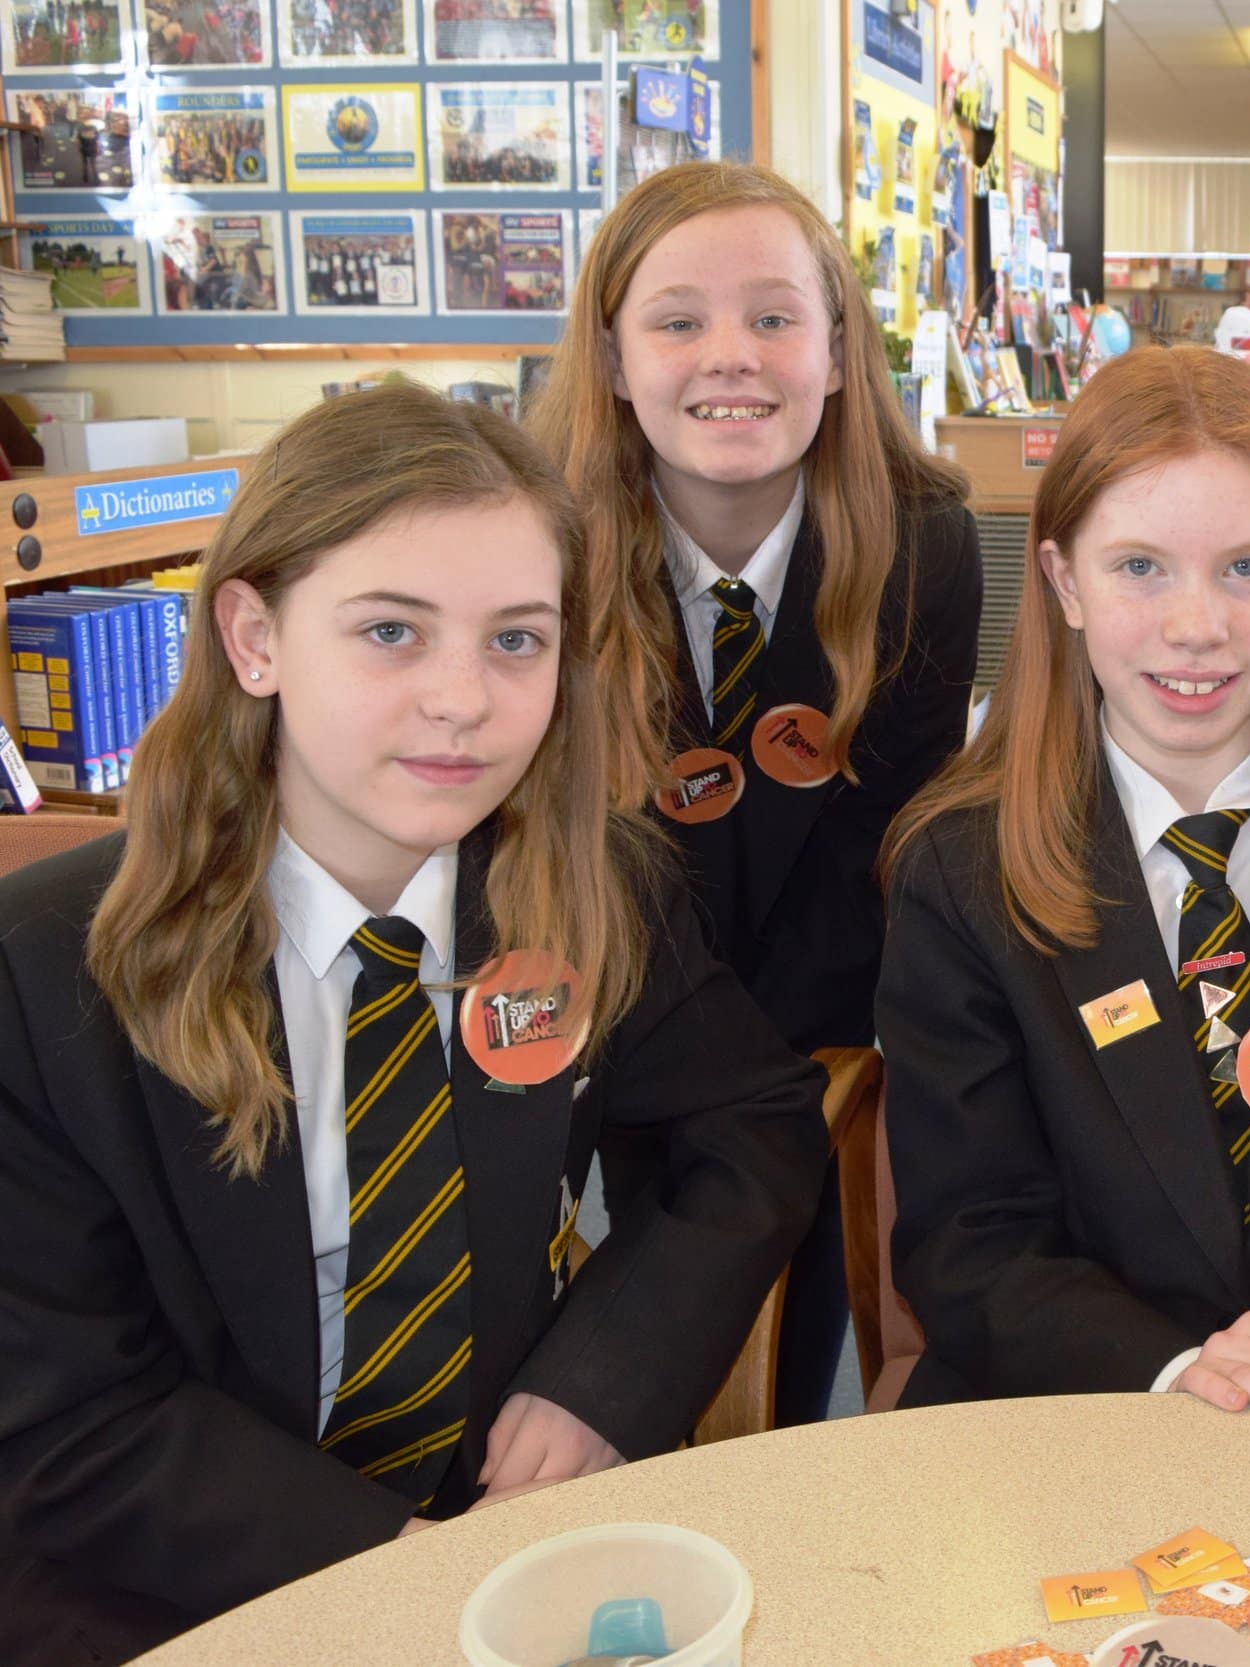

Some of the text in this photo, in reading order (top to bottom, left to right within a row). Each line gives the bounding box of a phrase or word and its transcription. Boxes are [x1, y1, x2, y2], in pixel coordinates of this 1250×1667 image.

[101, 481, 216, 521] Dictionaries
[163, 603, 180, 683] OXFORD
[687, 772, 721, 789] STAND
[690, 785, 704, 797] UP
